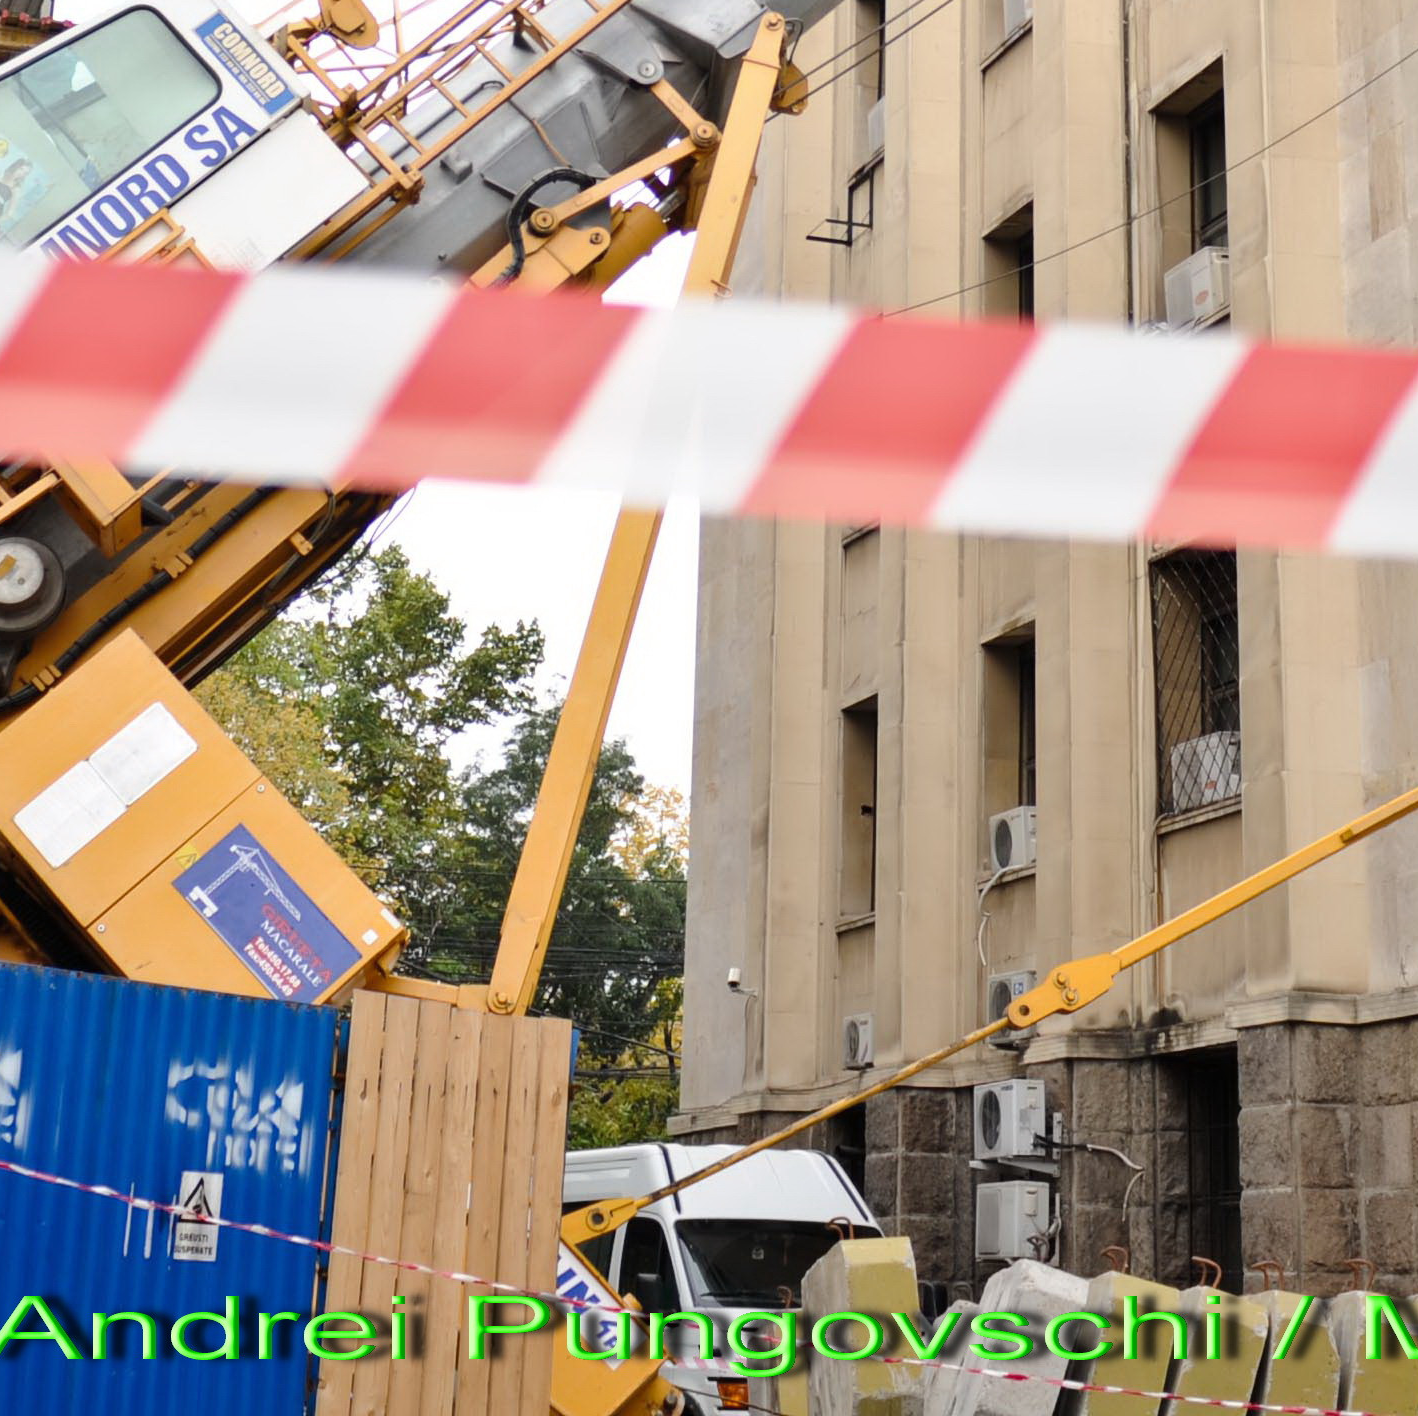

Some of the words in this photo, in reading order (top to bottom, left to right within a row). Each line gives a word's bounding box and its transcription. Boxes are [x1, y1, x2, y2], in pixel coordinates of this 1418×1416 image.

[213, 22, 286, 99] COMNORD
[183, 105, 258, 168] SA
[260, 919, 322, 988] MACARALE
